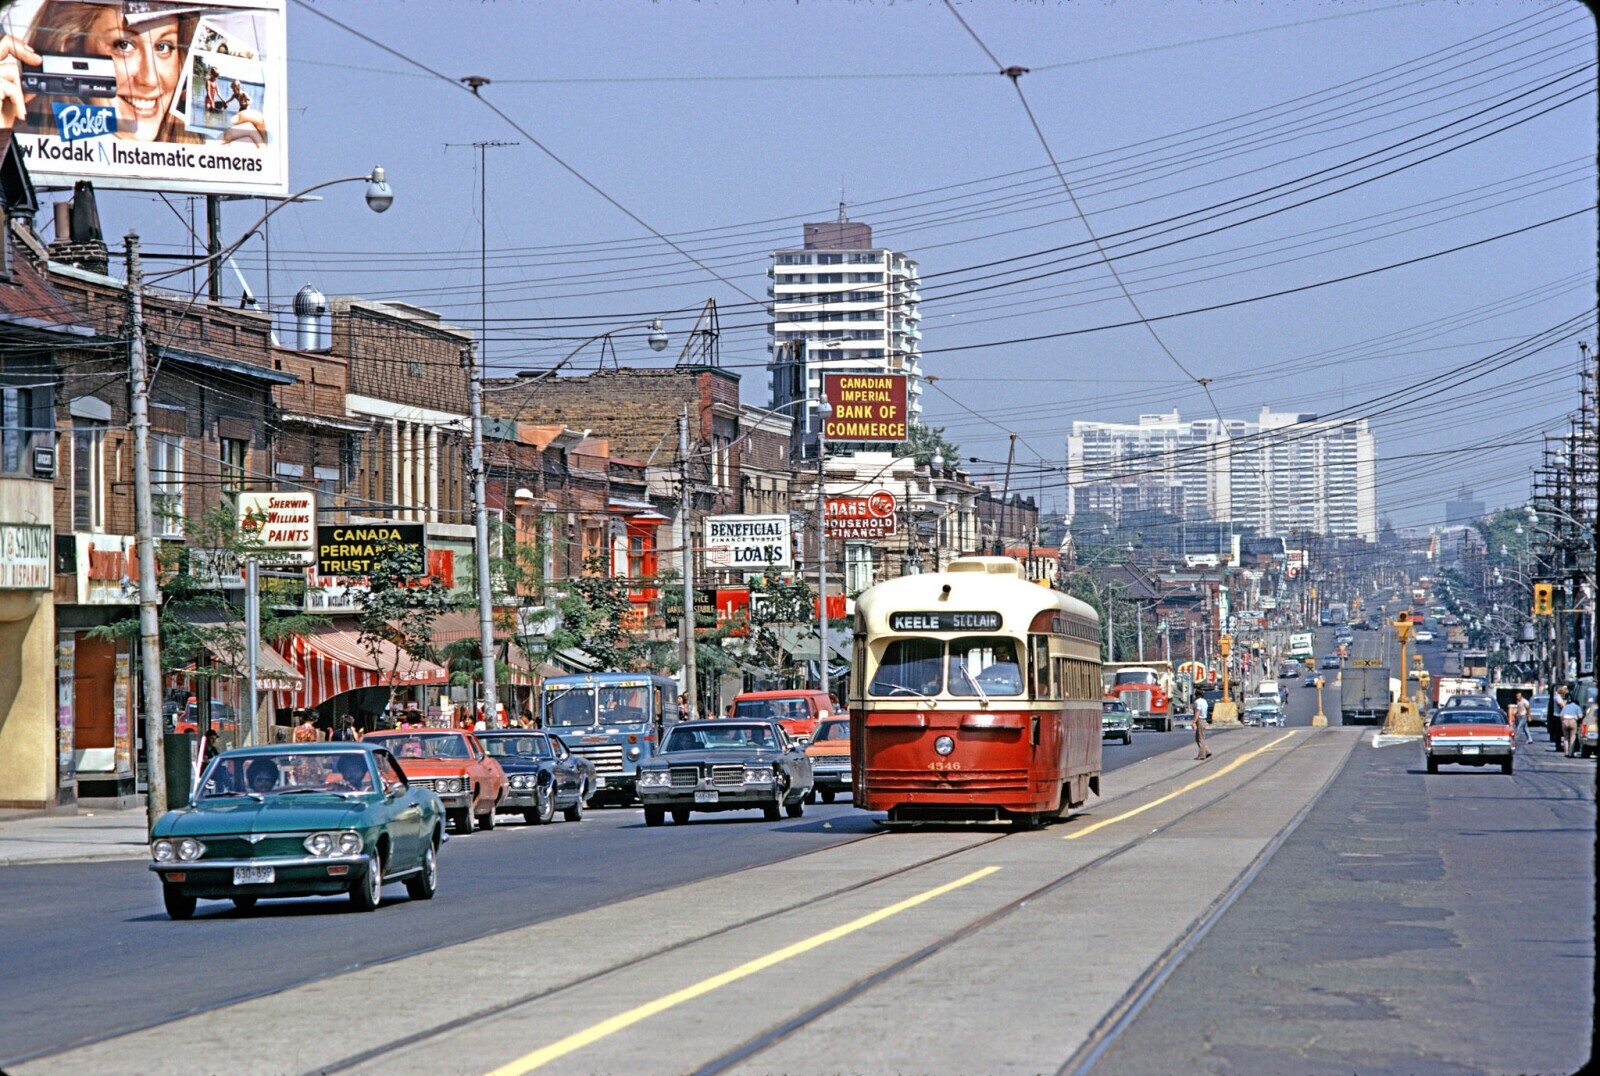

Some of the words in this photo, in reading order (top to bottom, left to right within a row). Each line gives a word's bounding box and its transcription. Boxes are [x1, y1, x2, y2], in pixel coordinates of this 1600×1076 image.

[58, 105, 113, 140] Pocket
[38, 137, 94, 162] Kodak
[112, 142, 195, 169] Instamatic
[198, 154, 263, 173] cameras
[840, 378, 892, 389] CANADIAN
[841, 390, 891, 402] IMPERIAL
[836, 404, 873, 419] BANK
[879, 405, 897, 419] OF
[827, 422, 905, 437] COMMERCE
[268, 497, 310, 509] SHERWIN-
[267, 512, 310, 524] WILLIAMS
[824, 518, 892, 528] HOUSEHOLD
[333, 528, 402, 542] CANADA
[711, 523, 781, 536] BENEFICIAL
[831, 528, 883, 538] FINANCE
[268, 530, 309, 542] PAINTS
[15, 526, 49, 559] SAVINGS
[321, 560, 371, 572] TRUST
[894, 616, 939, 629] KEELE
[927, 762, 961, 770] 4546
